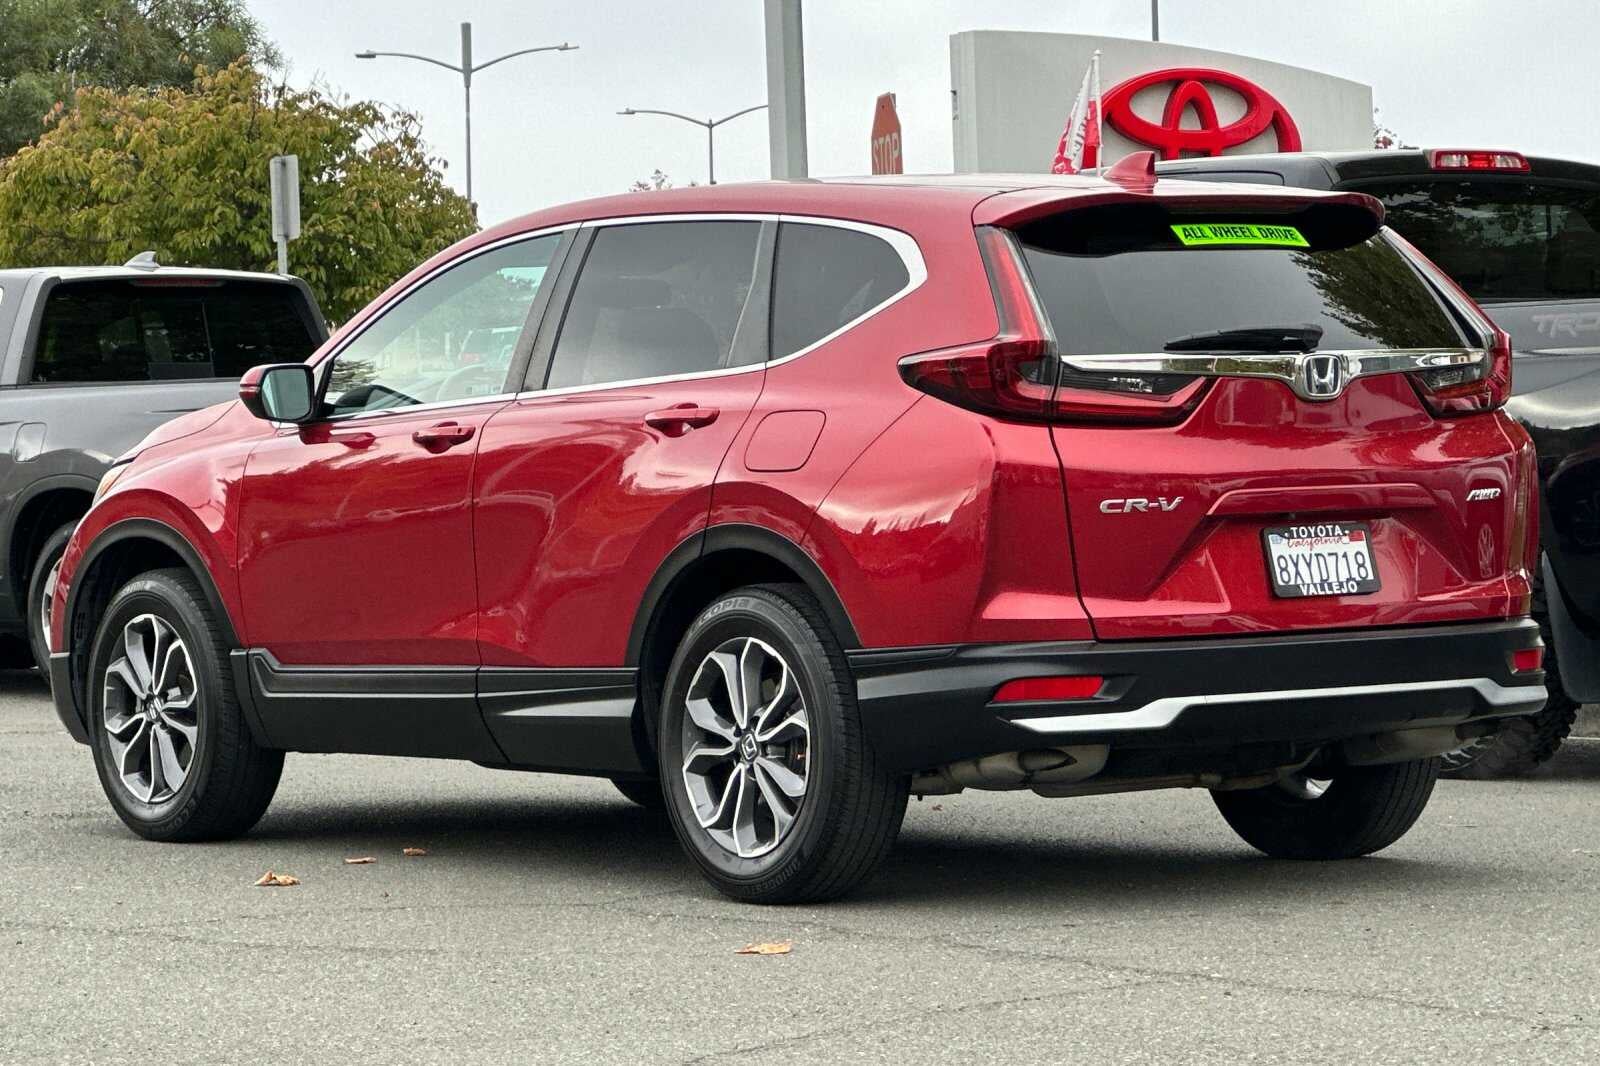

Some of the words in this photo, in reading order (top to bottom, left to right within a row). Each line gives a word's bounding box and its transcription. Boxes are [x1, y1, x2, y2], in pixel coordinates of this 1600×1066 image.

[871, 132, 900, 174] STOP
[1182, 226, 1209, 240] ALL
[1208, 225, 1257, 239] WHEEL
[1256, 226, 1299, 240] DRIVE
[1466, 488, 1501, 501] AWD
[1099, 496, 1184, 514] CR-V
[1289, 525, 1343, 539] TOYOTA
[1276, 551, 1369, 585] 8XYD718
[1299, 581, 1358, 596] VALLEJO
